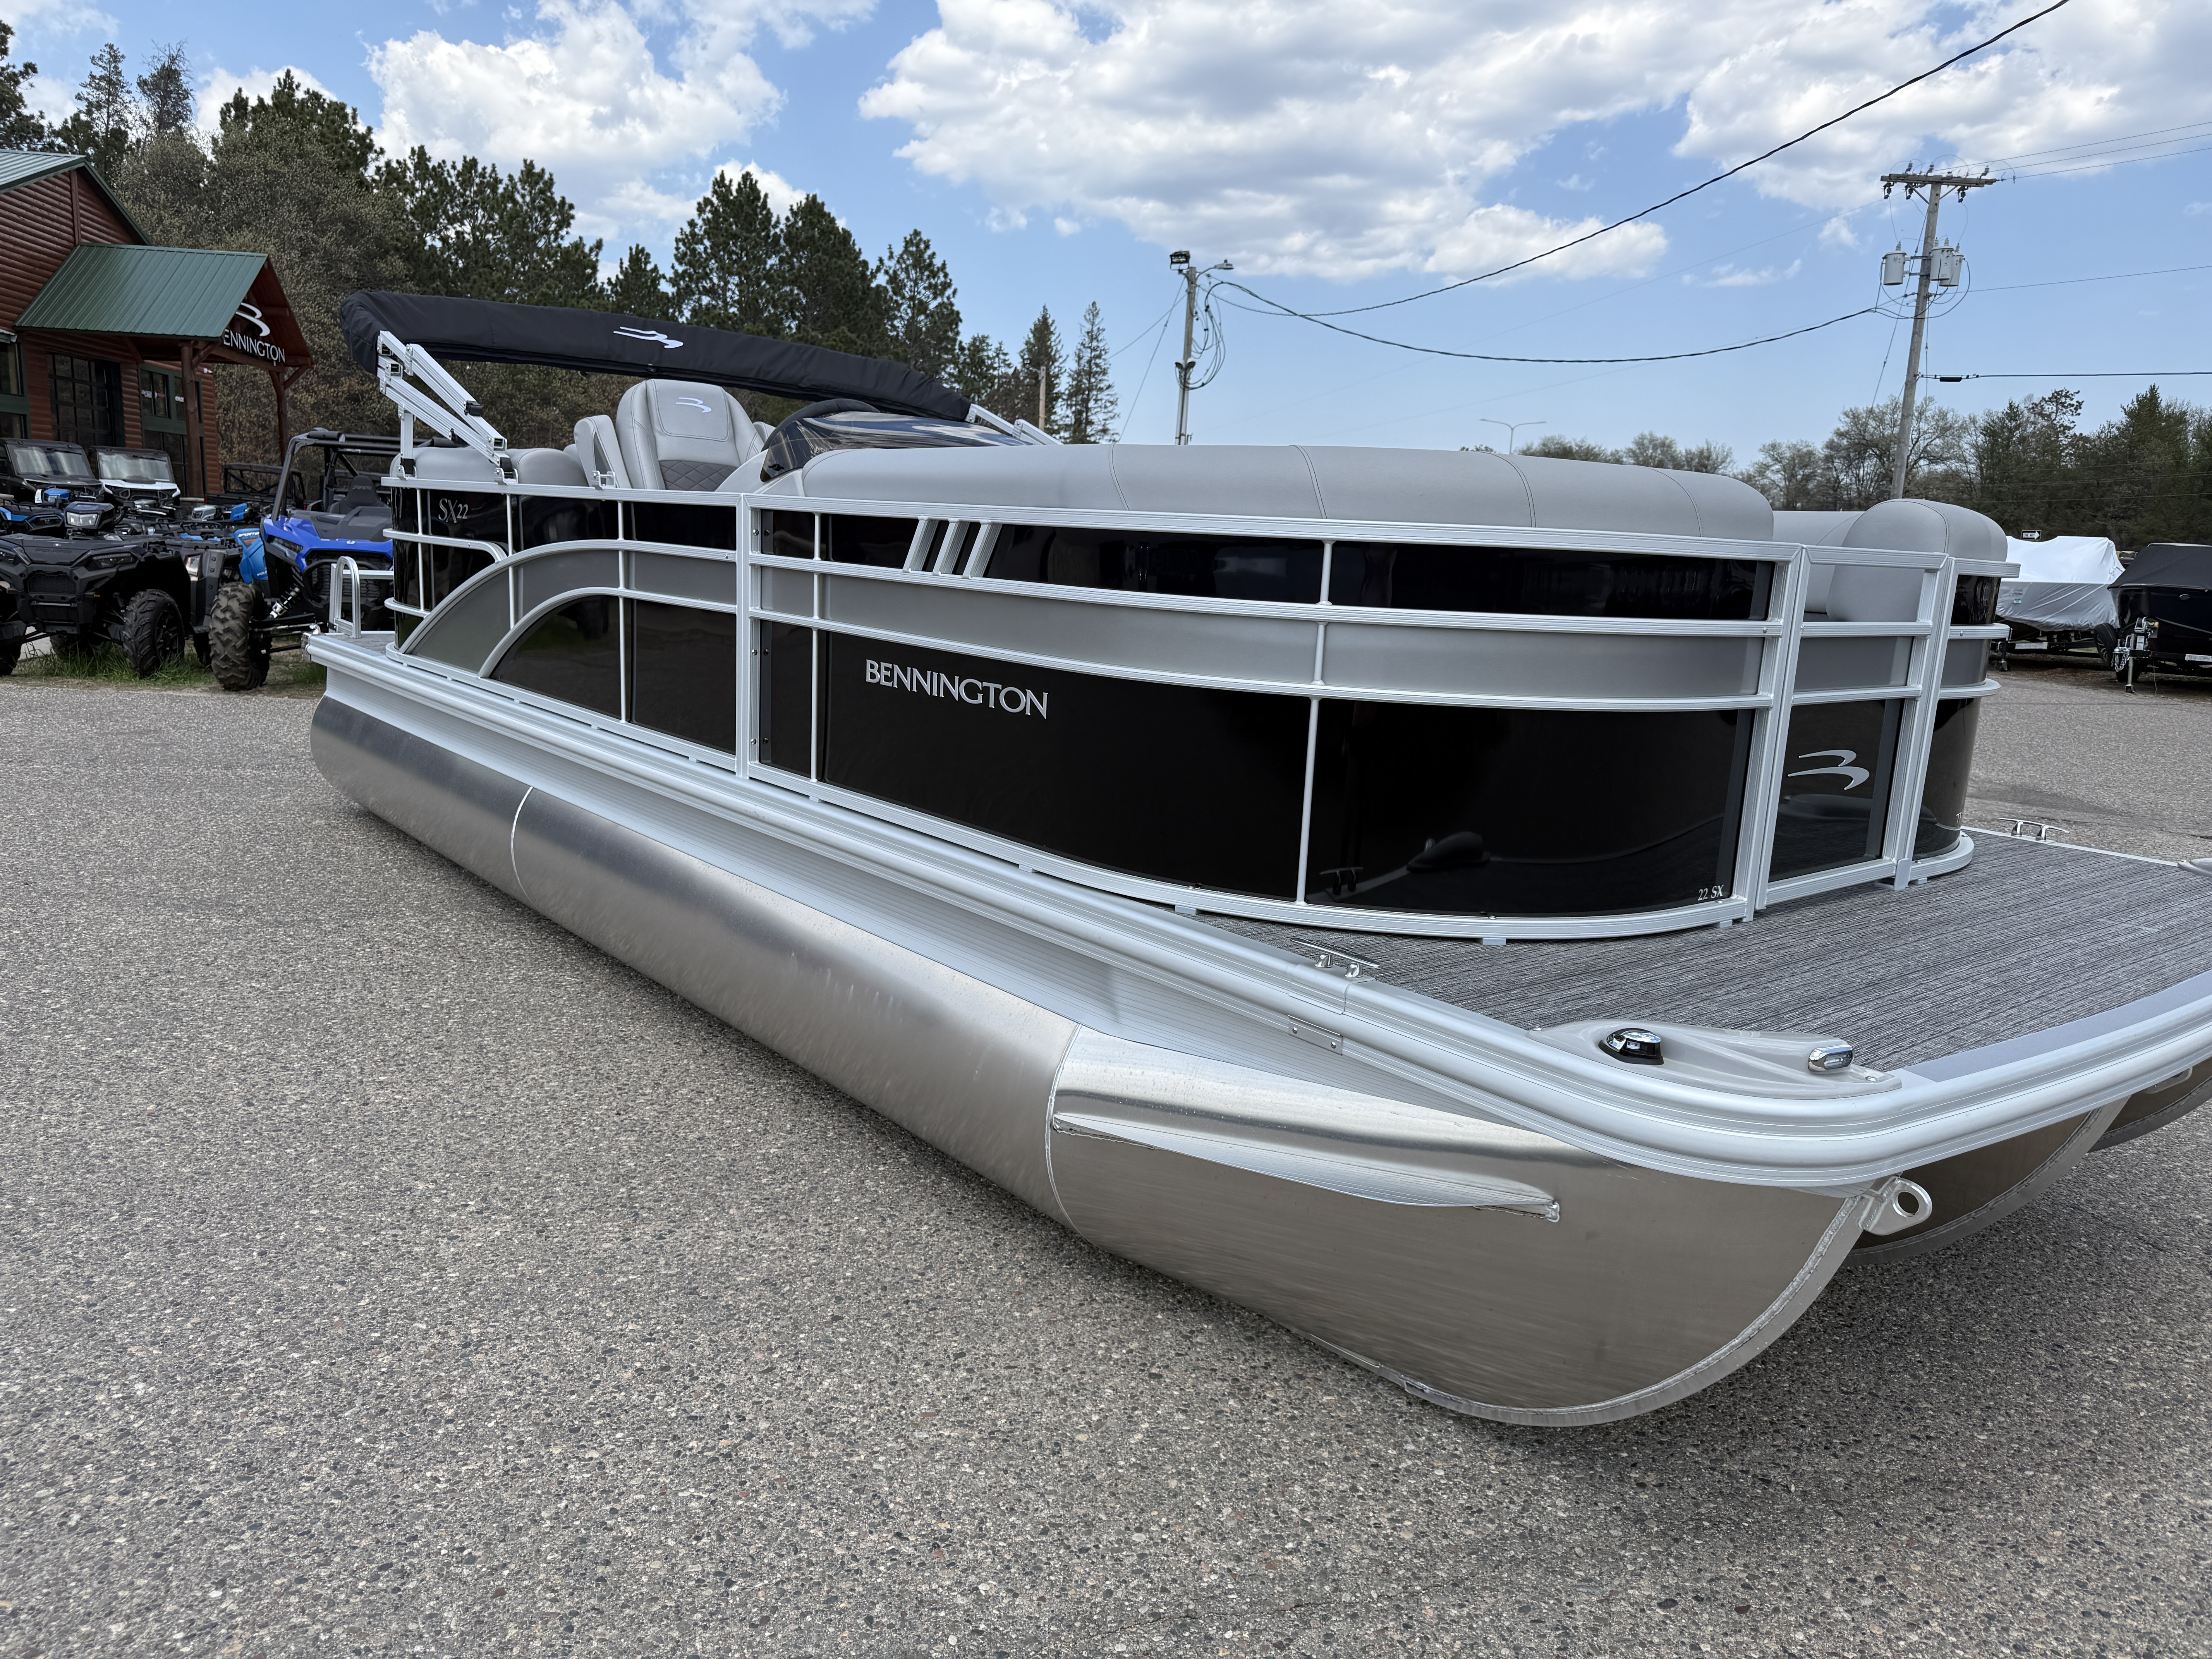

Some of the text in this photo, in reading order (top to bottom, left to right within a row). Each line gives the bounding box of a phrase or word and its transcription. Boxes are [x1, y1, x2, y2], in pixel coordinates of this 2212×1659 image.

[223, 329, 285, 363] ENNINGTON
[438, 498, 468, 523] SX22
[866, 659, 1048, 719] BENNINGTON
[1698, 884, 1724, 901] 22 SX
